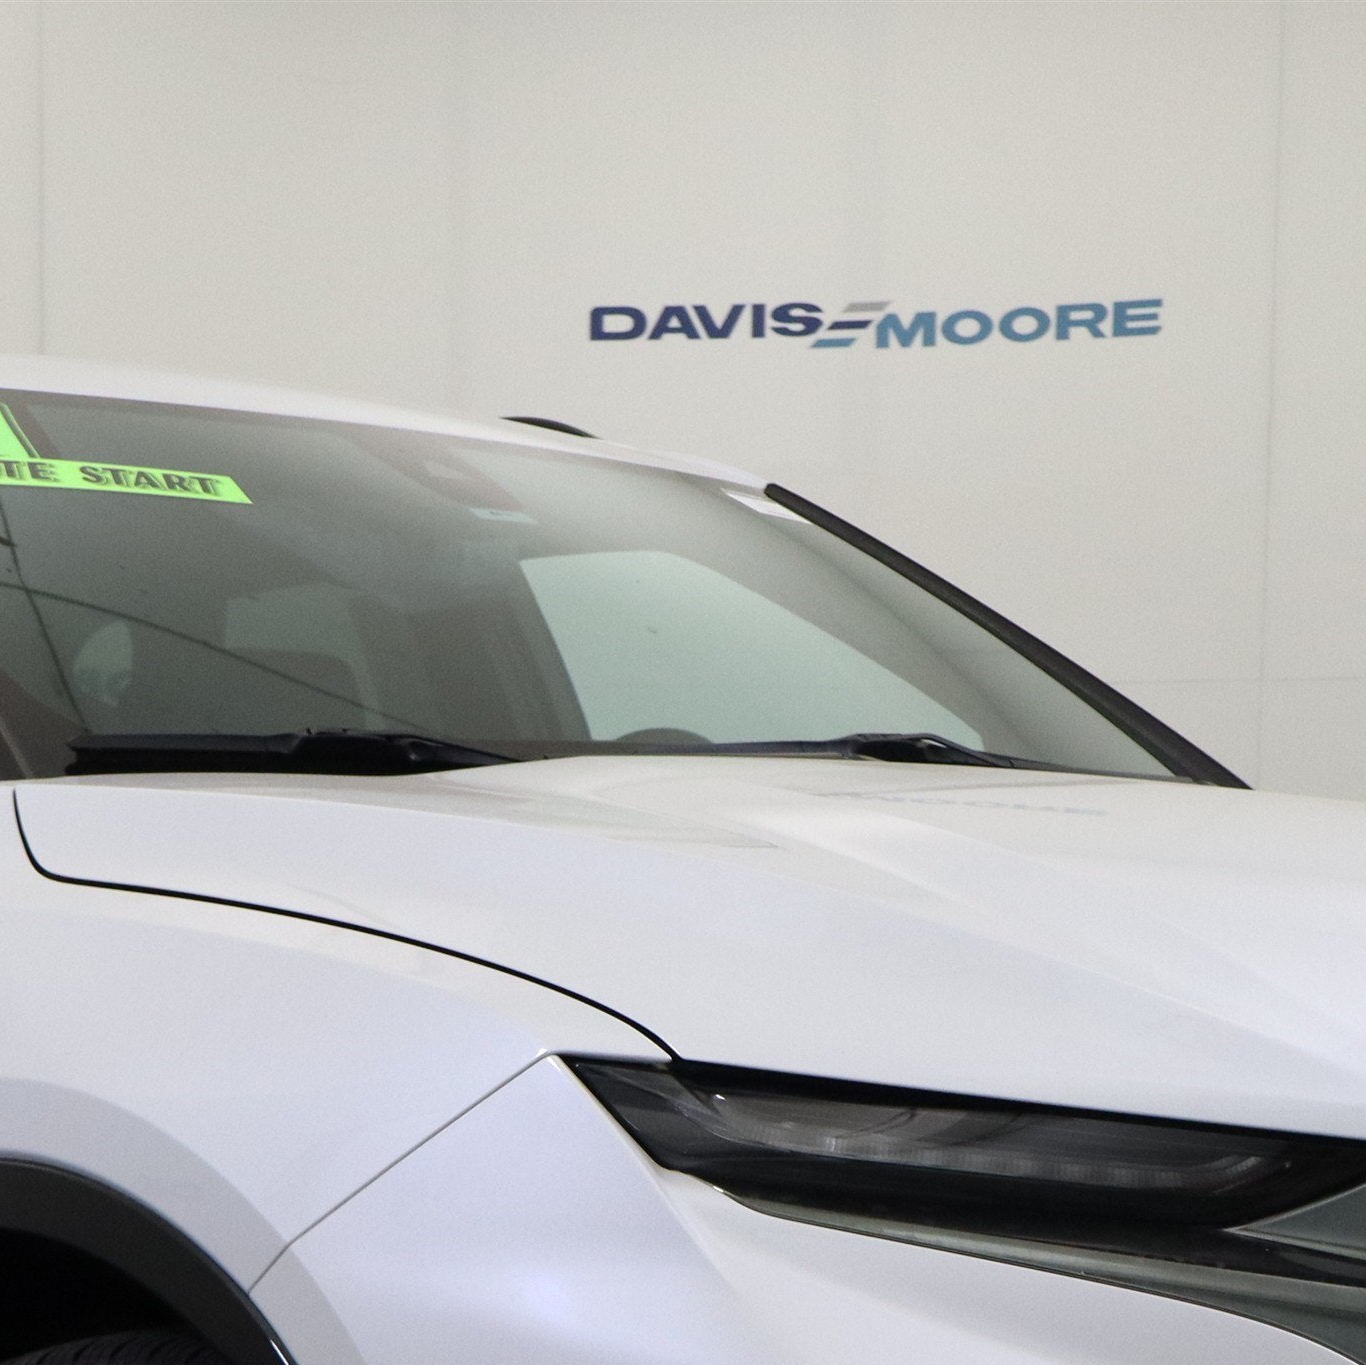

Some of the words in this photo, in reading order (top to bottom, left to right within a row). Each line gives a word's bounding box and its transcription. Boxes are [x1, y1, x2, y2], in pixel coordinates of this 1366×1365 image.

[589, 302, 823, 341] DAVIS
[875, 298, 1163, 349] MOORE
[80, 464, 221, 496] START
